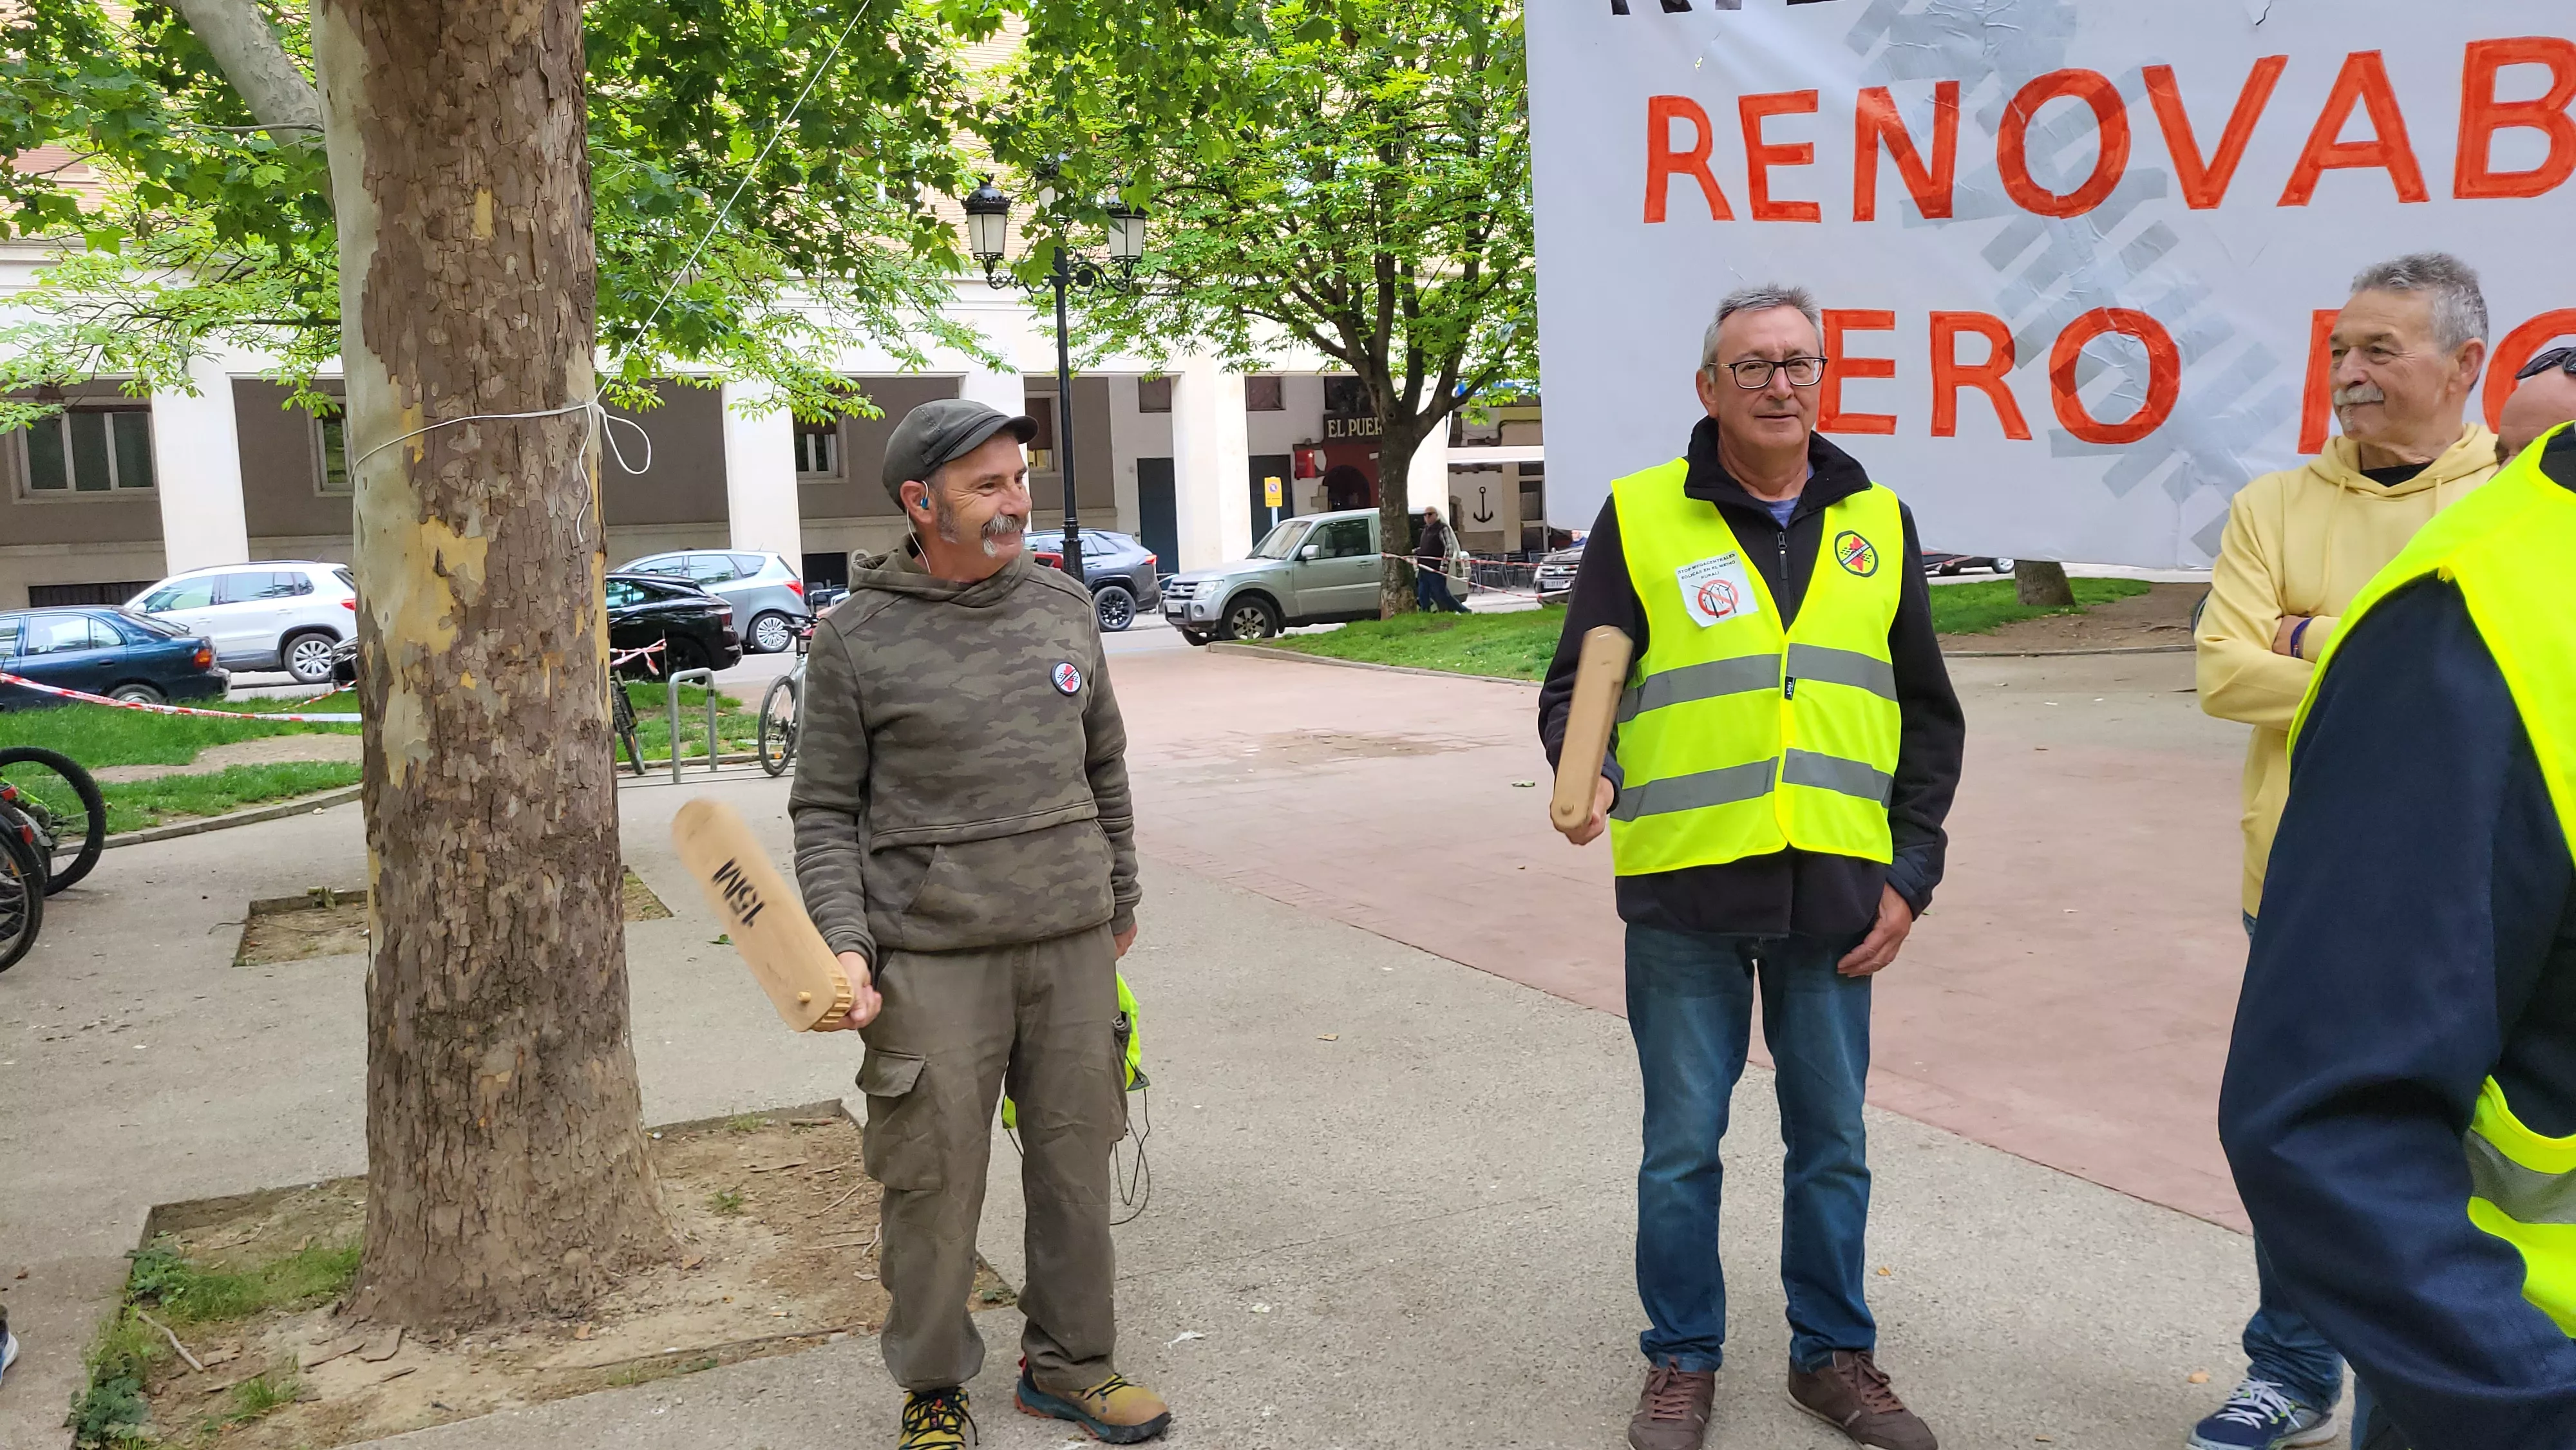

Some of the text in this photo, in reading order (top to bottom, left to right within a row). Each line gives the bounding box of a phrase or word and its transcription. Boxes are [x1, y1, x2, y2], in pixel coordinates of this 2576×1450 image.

[1643, 37, 2576, 223] RENOVAB
[1816, 308, 2182, 444] ERO
[1327, 419, 1346, 438] EL
[1692, 553, 1736, 569] MEGACENTRALES
[710, 856, 765, 928] 15M
